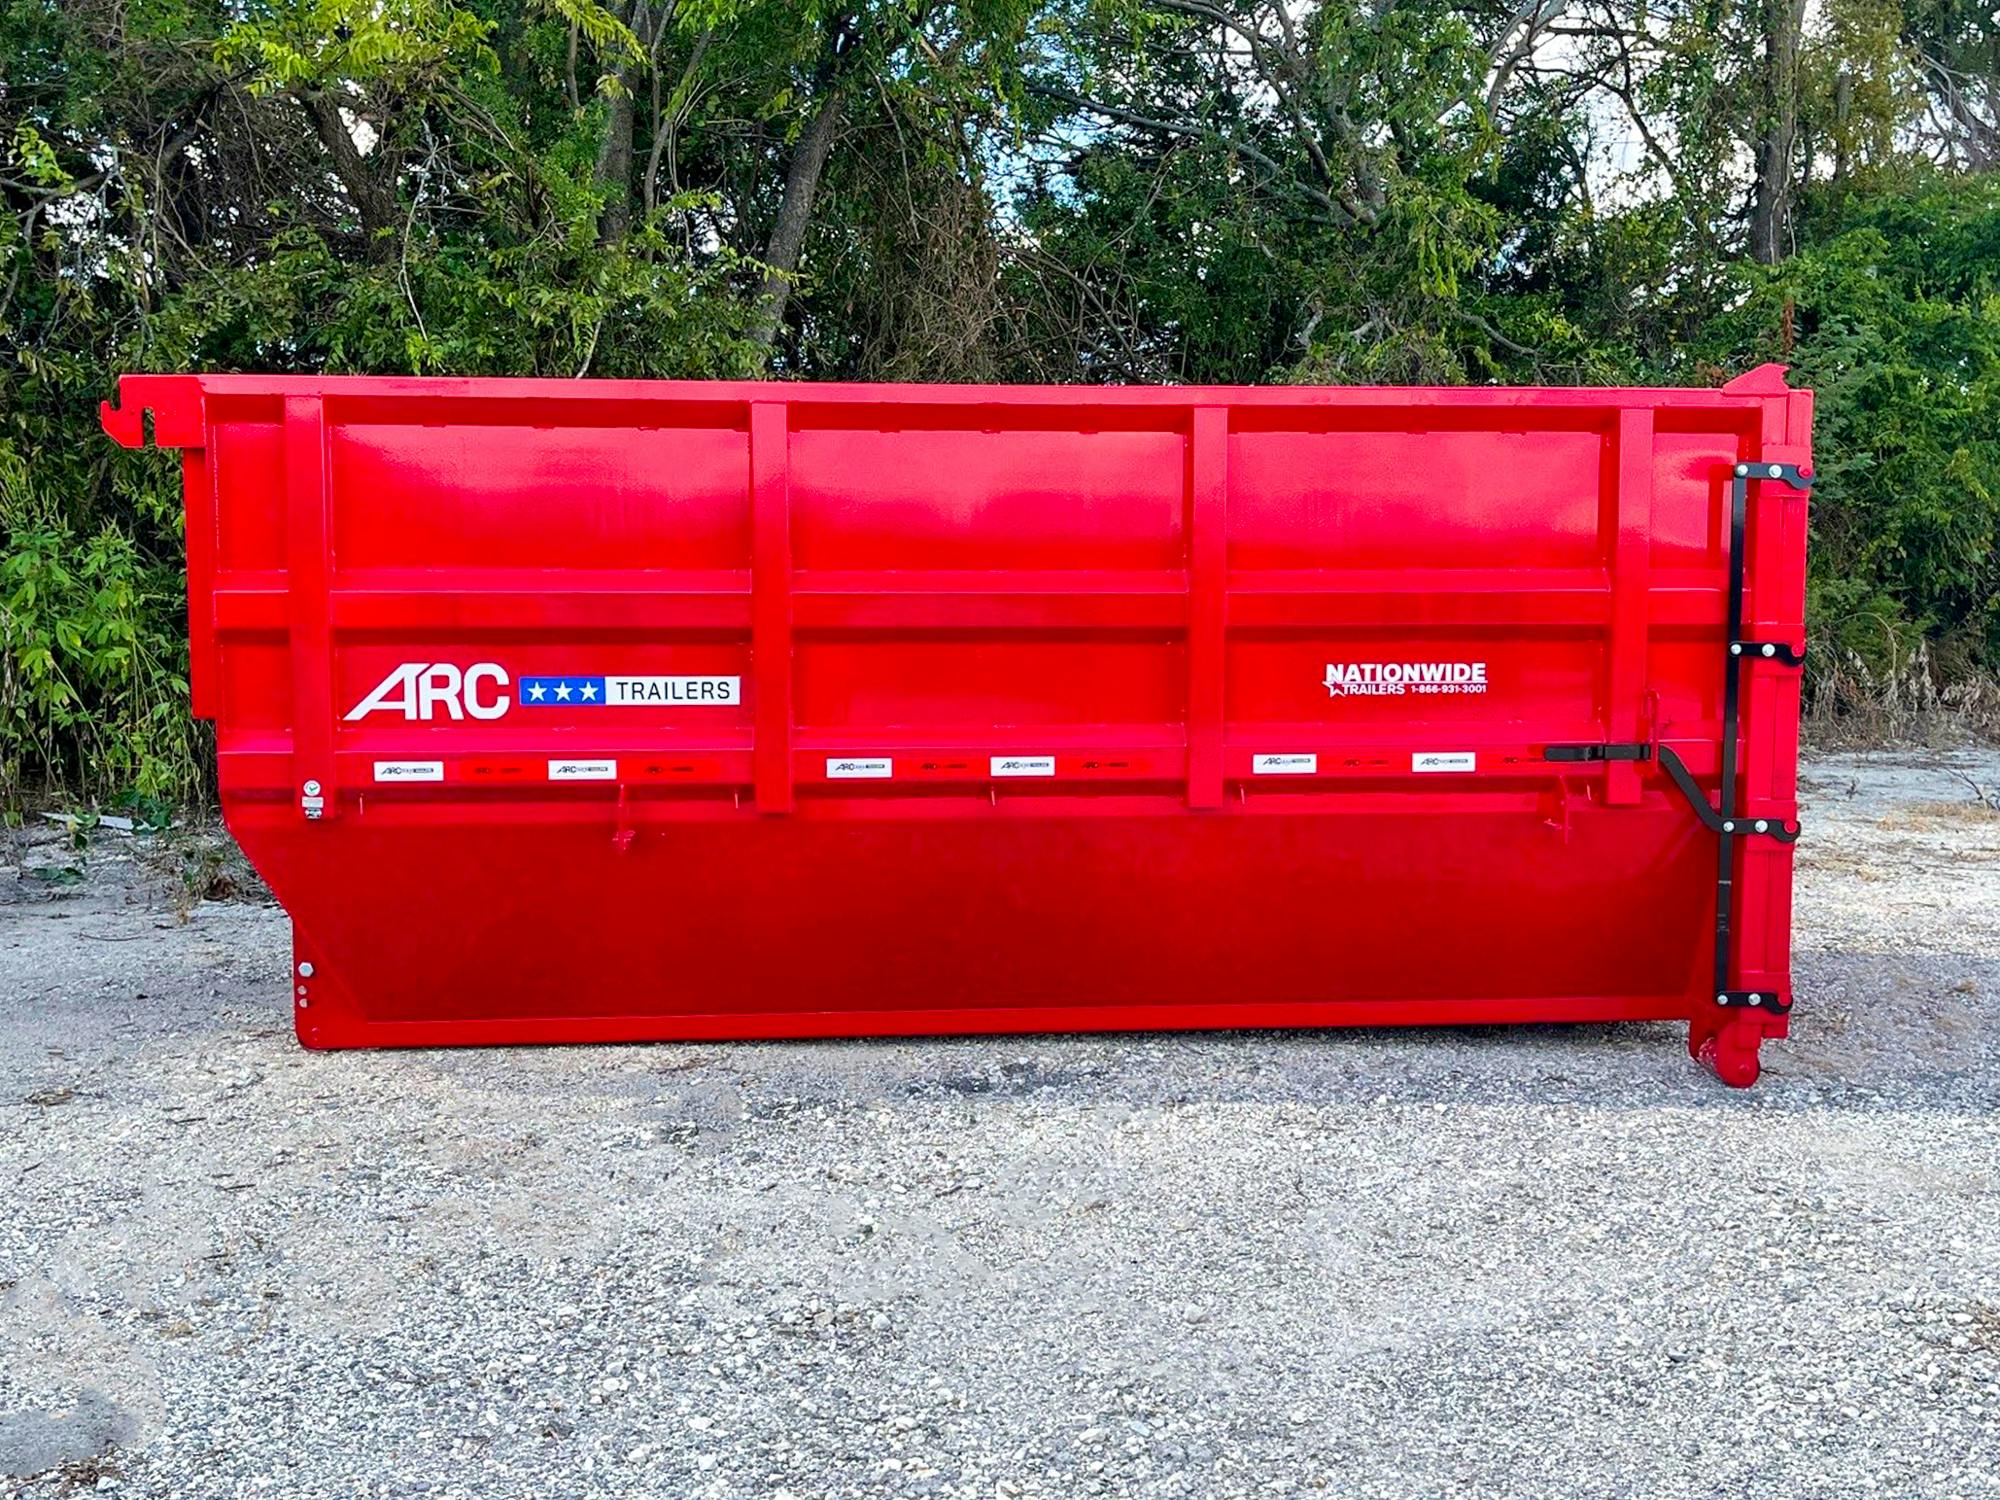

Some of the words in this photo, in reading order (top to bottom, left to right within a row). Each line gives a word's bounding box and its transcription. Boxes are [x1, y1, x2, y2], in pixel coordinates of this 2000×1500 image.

[1325, 662, 1487, 682] NATIONWIDE
[342, 662, 510, 721] ARC
[616, 681, 731, 700] TRAILERS
[1342, 684, 1405, 695] TRAILERS
[1411, 685, 1487, 694] 1-866-931-3001
